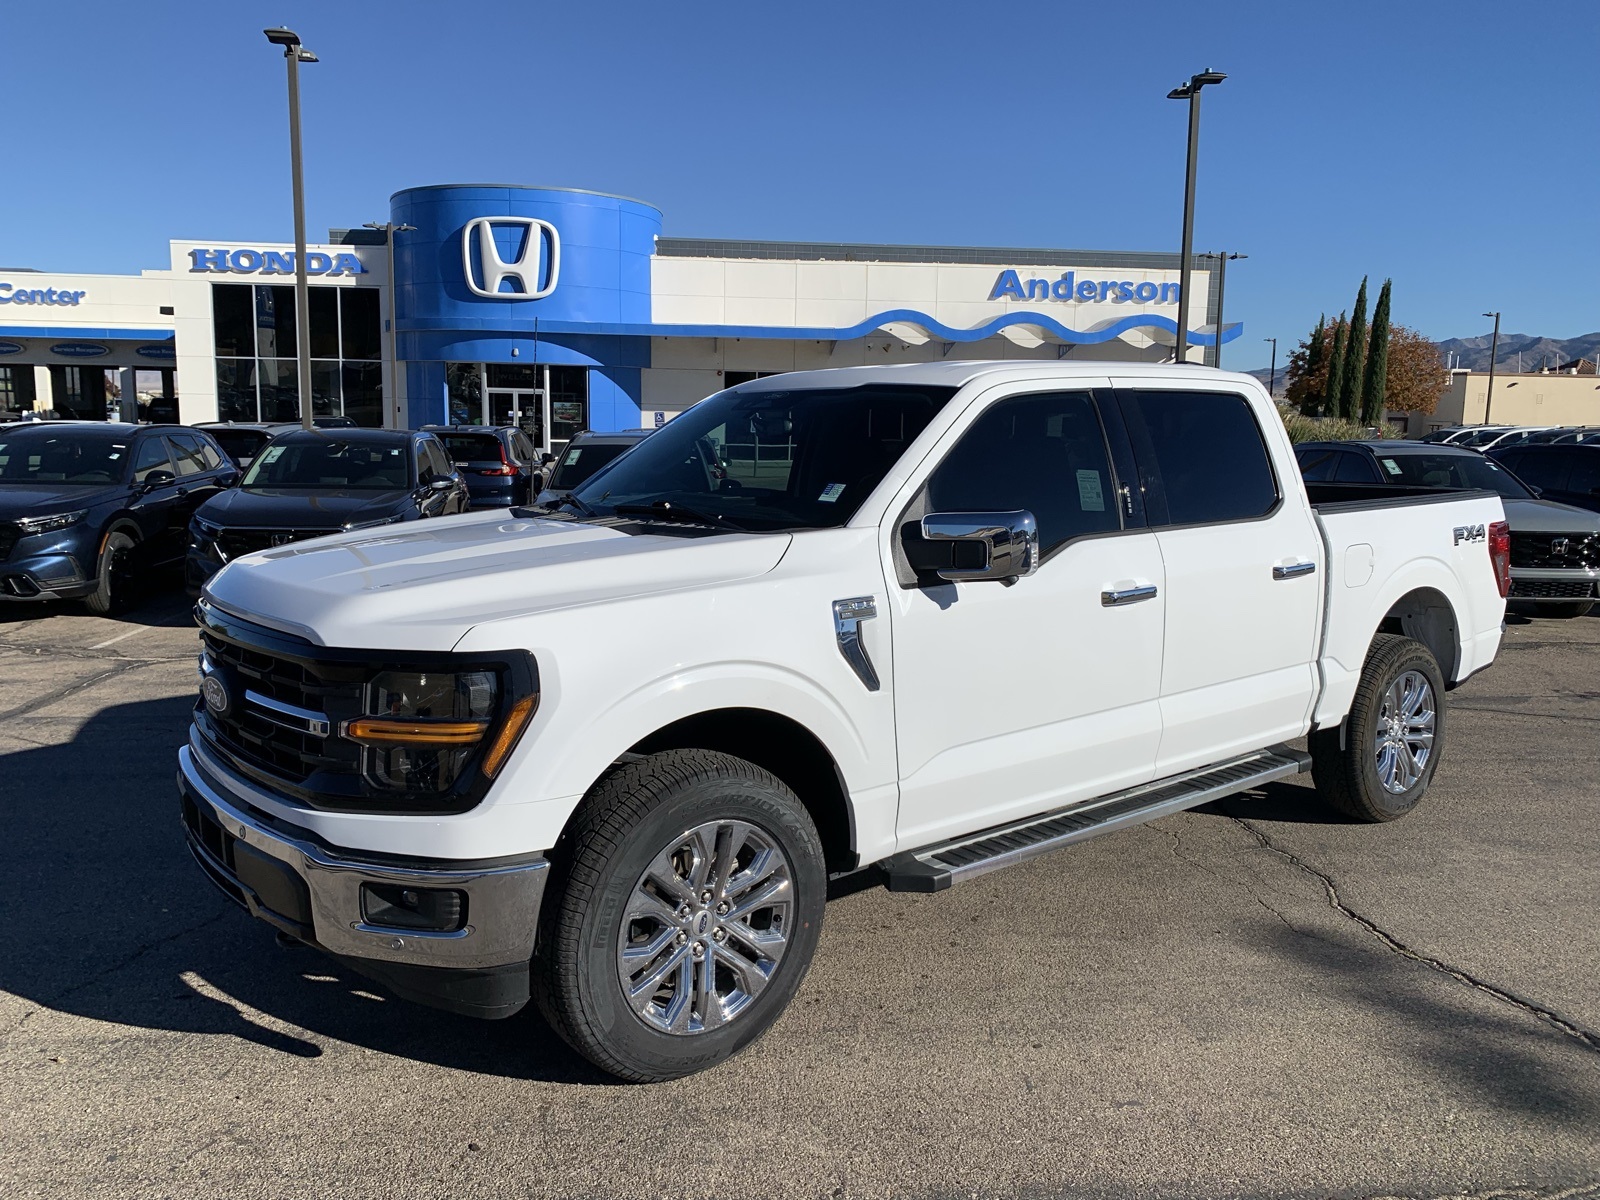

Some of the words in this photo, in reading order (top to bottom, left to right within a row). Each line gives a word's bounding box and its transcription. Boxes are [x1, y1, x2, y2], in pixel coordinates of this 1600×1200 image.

[189, 249, 368, 276] HONDA
[0, 282, 86, 306] Center
[993, 269, 1181, 303] Anderson
[1453, 524, 1485, 546] FX4
[207, 681, 222, 707] Ford
[682, 793, 788, 821] SCORPION
